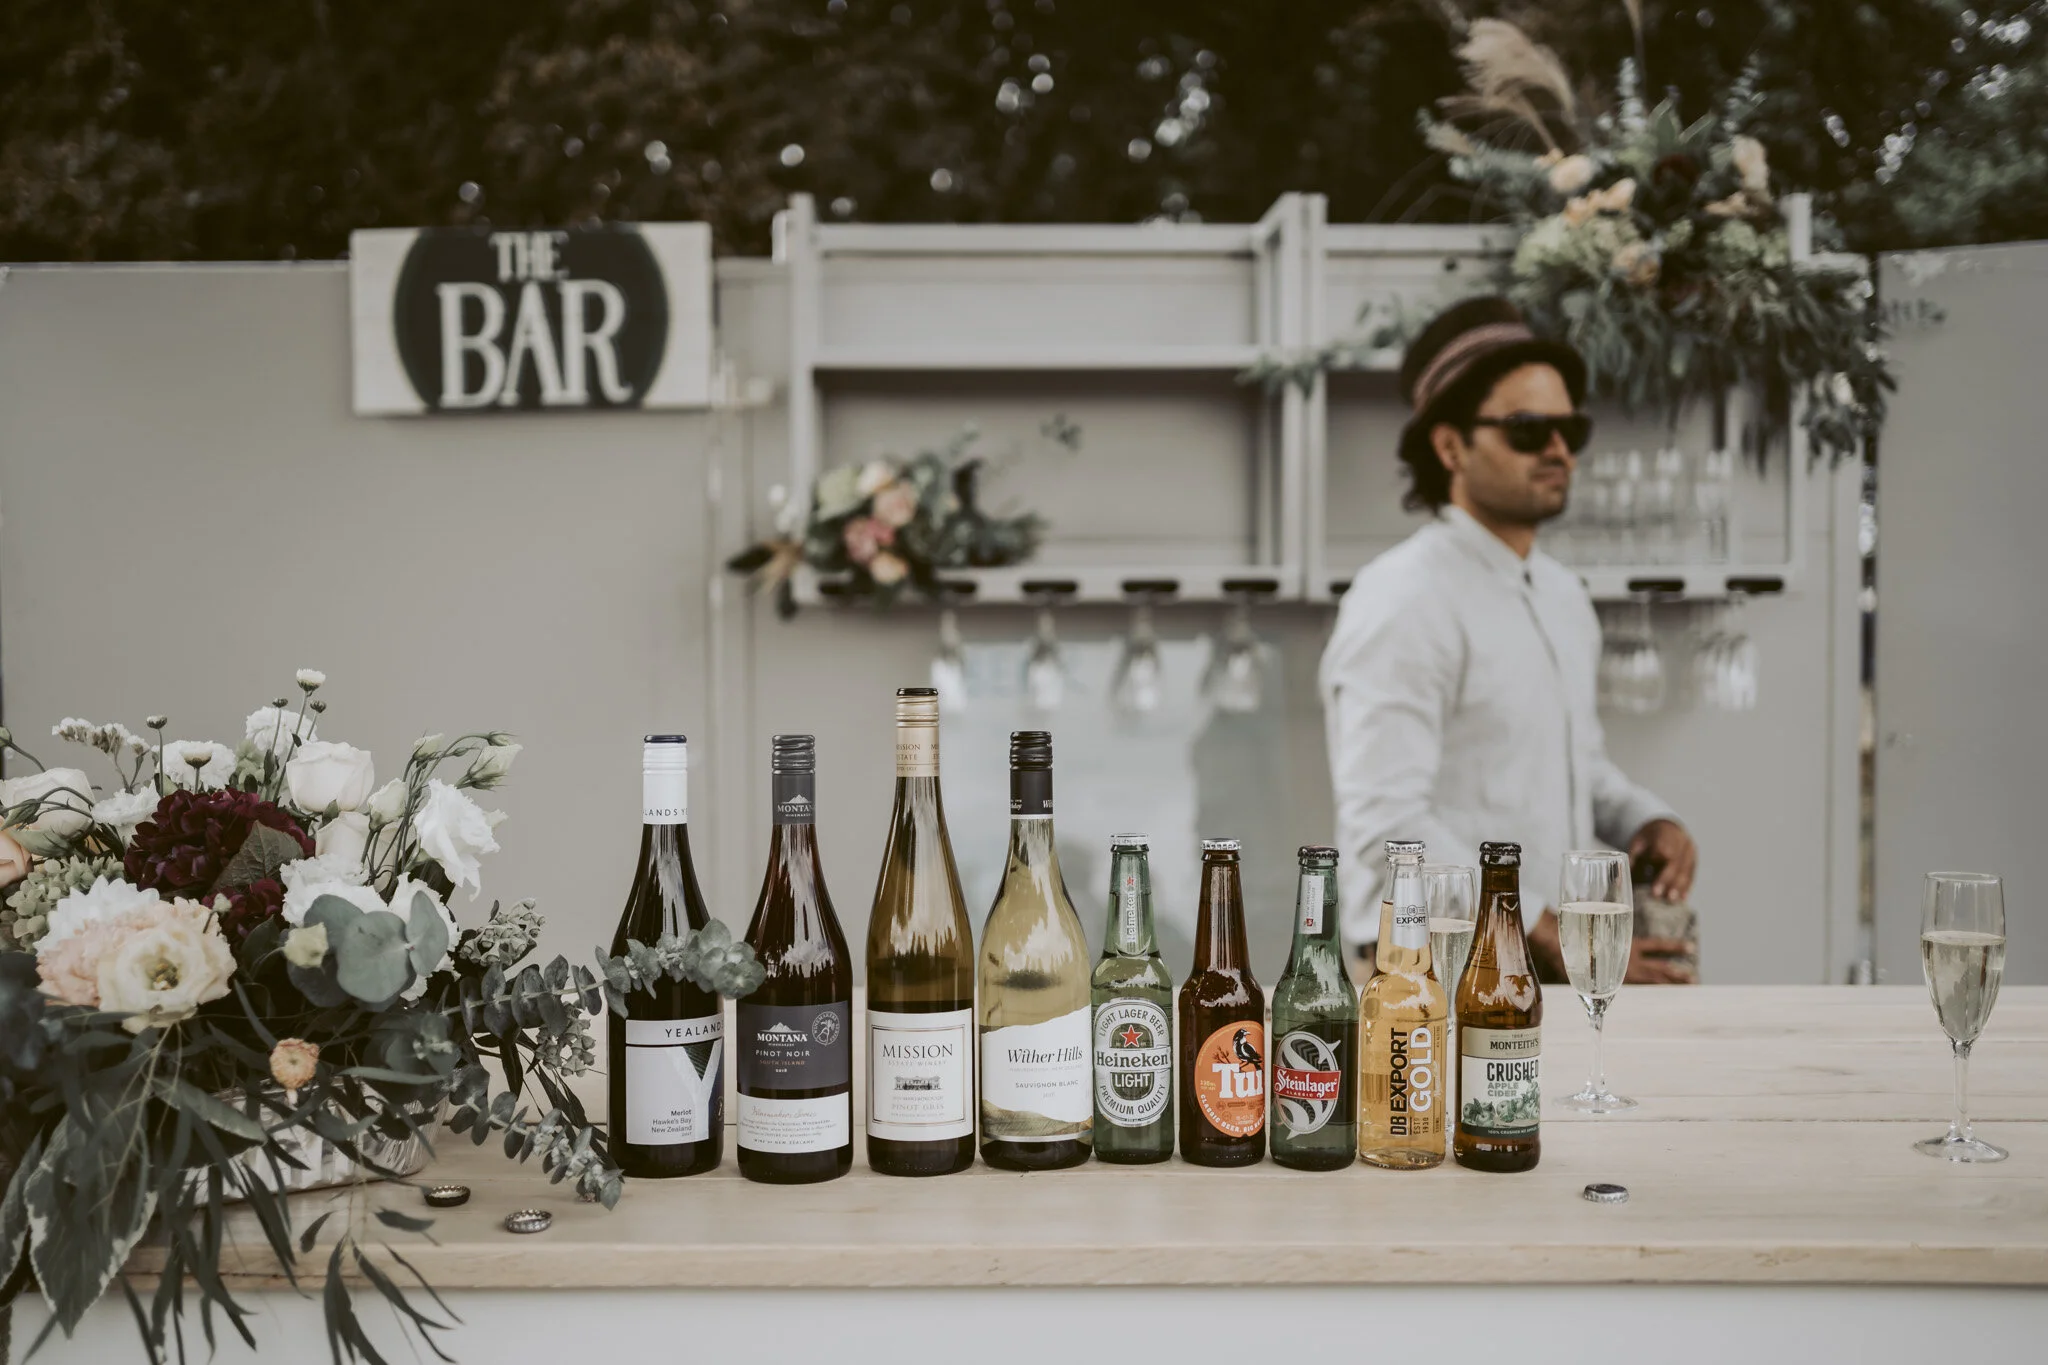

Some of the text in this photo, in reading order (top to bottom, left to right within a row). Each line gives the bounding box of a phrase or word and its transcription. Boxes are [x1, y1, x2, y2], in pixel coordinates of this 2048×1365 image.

[490, 231, 569, 282] THE
[436, 279, 633, 407] BAR
[1396, 916, 1426, 924] EXPORT
[1100, 1009, 1165, 1037] LIGHT LAGER BEER
[757, 1034, 807, 1042] MONTANA
[882, 1044, 953, 1059] MISSION
[1008, 1046, 1083, 1064] Wither Hills
[1096, 1051, 1168, 1068] Heineken
[1410, 1027, 1432, 1112] GOLD
[1487, 1060, 1539, 1081] CRUSHED
[1115, 1074, 1150, 1087] LIGHT
[1275, 1069, 1337, 1098] Steinlager
[1390, 1028, 1408, 1135] DB EXPORT
[1100, 1085, 1166, 1115] PREMIUM QUALITY
[1200, 1094, 1221, 1123] CLASSIC
[653, 1117, 692, 1125] Hawke's Bay
[667, 1125, 692, 1133] Zealand
